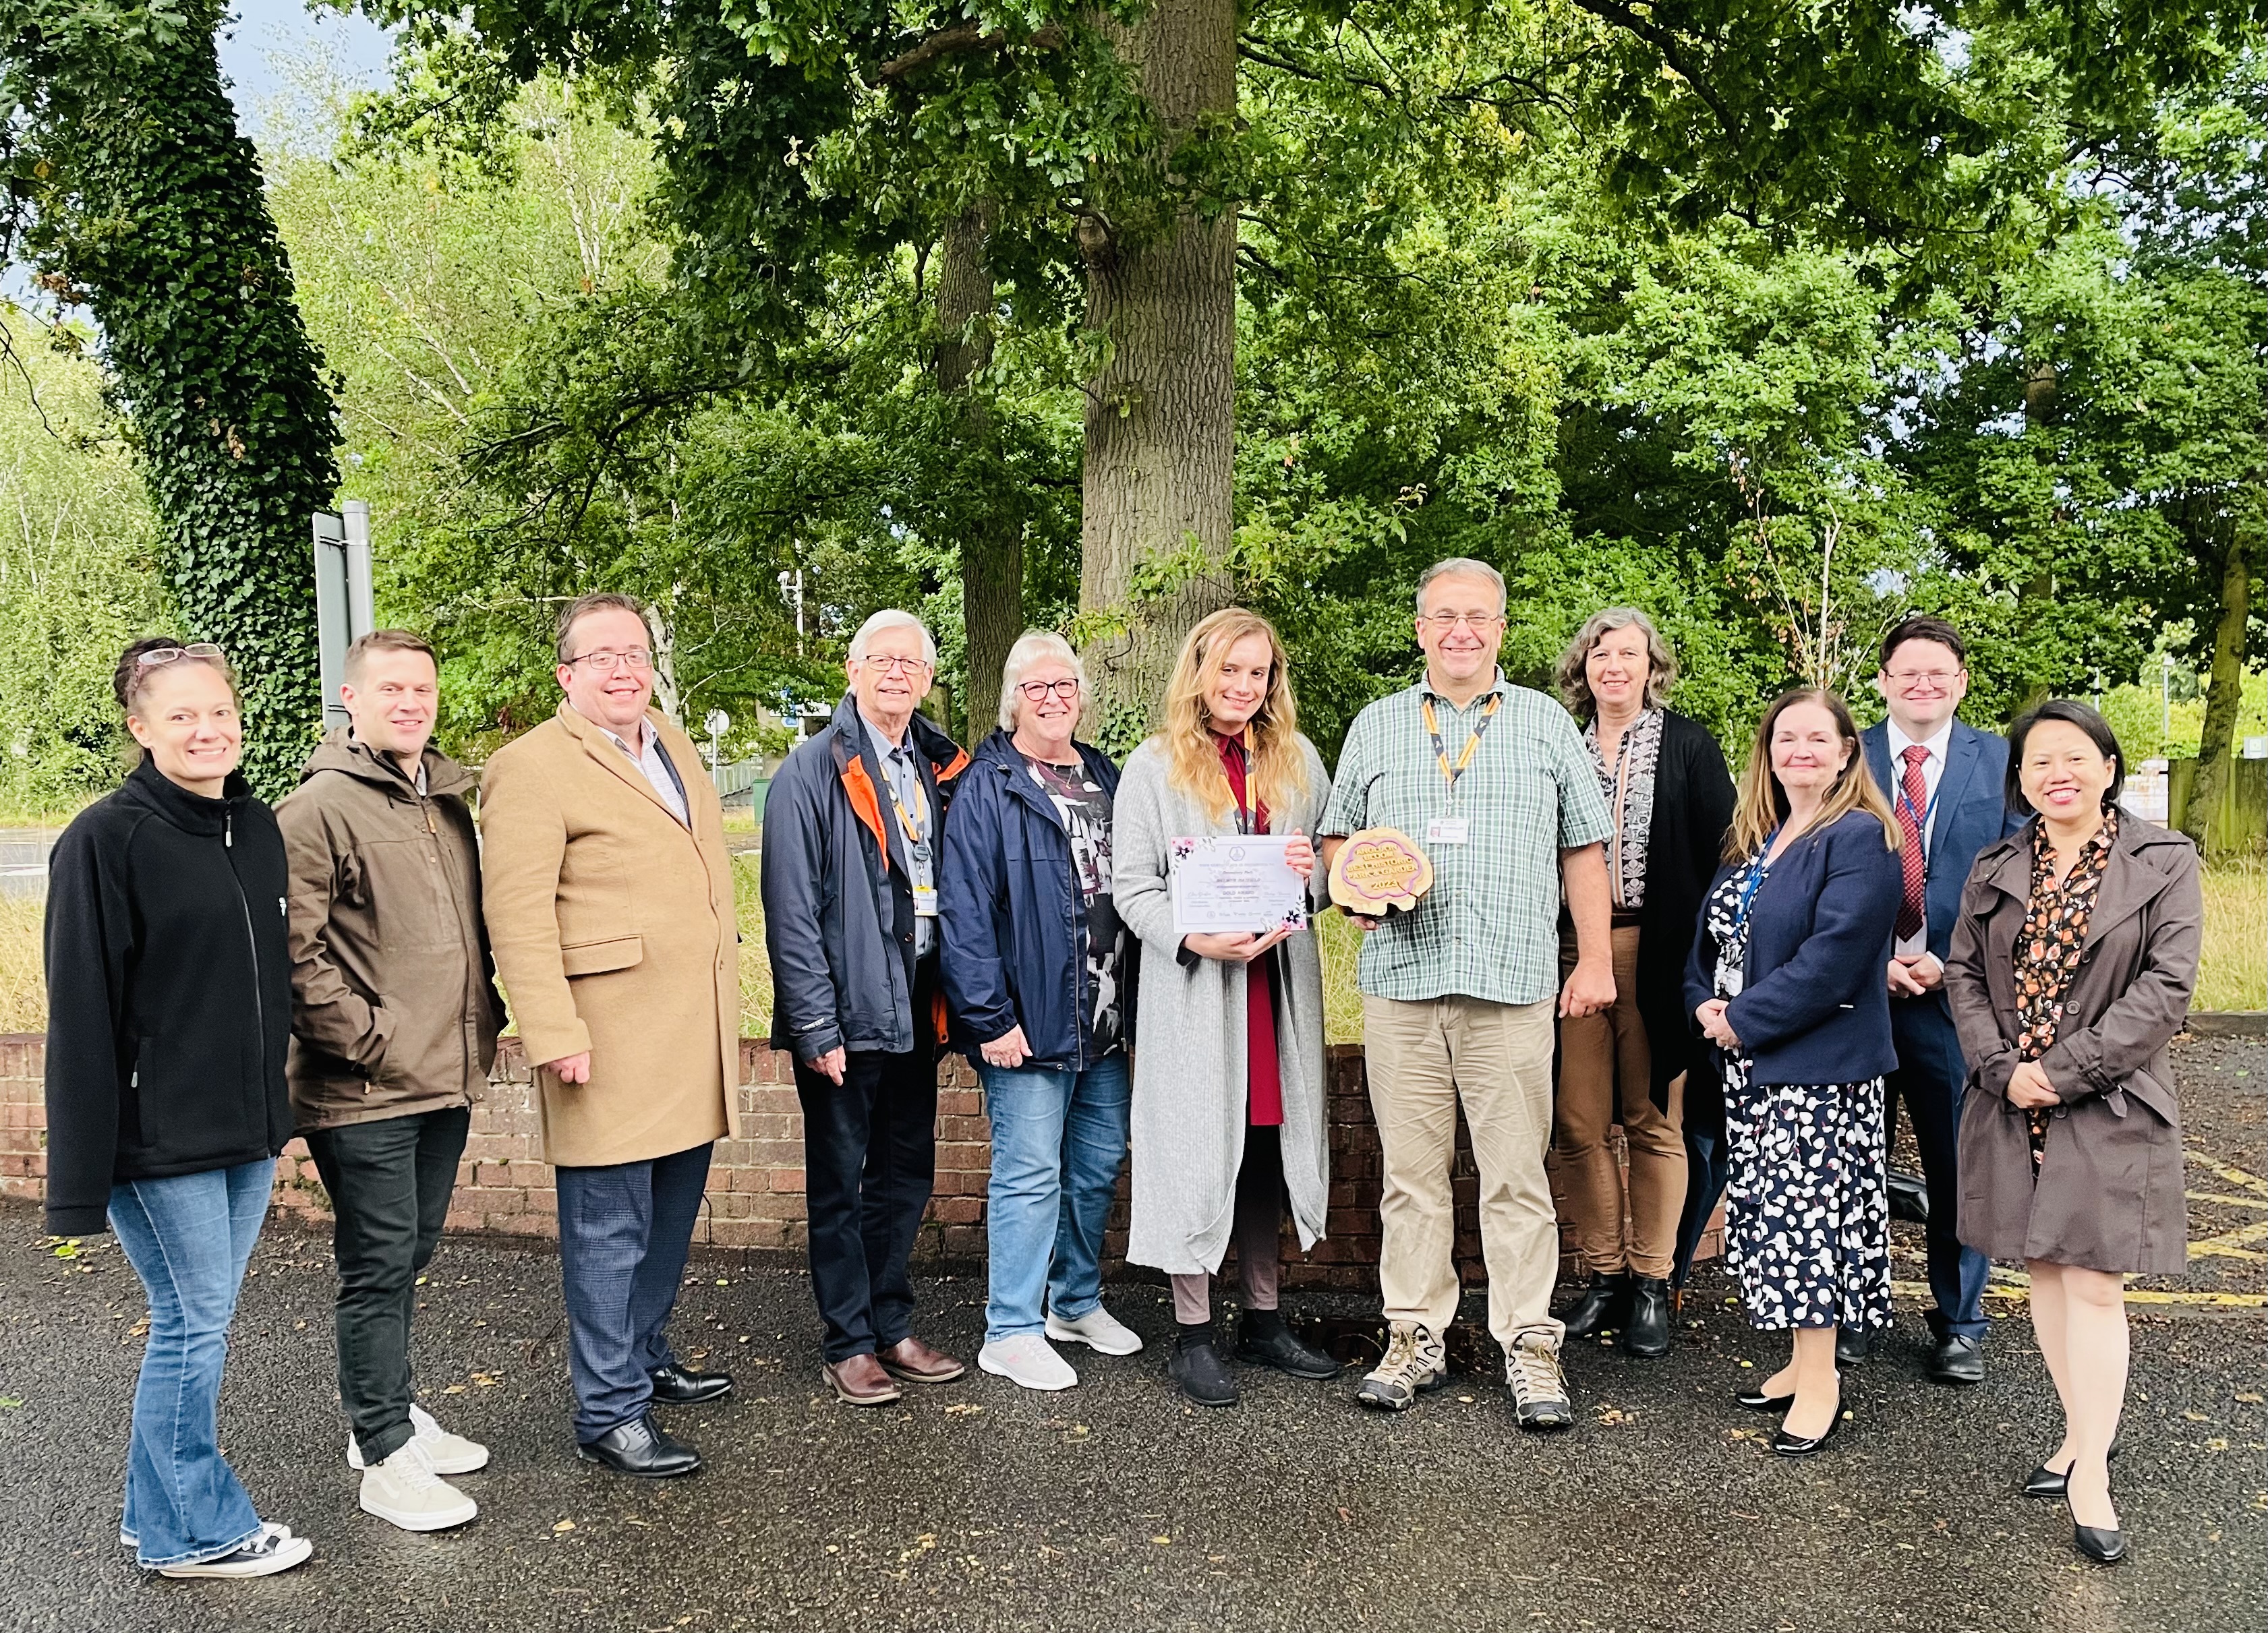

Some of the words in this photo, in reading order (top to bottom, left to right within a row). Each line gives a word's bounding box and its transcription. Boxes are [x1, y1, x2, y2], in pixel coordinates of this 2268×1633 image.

[1356, 845, 1387, 855] ANGLIA
[1364, 852, 1394, 861] BLOOM
[1347, 863, 1370, 872] BEST
[1372, 858, 1413, 868] HISTORIC
[1347, 870, 1371, 880] PARK
[1382, 866, 1418, 875] GARDEN
[1372, 880, 1397, 889] 2023
